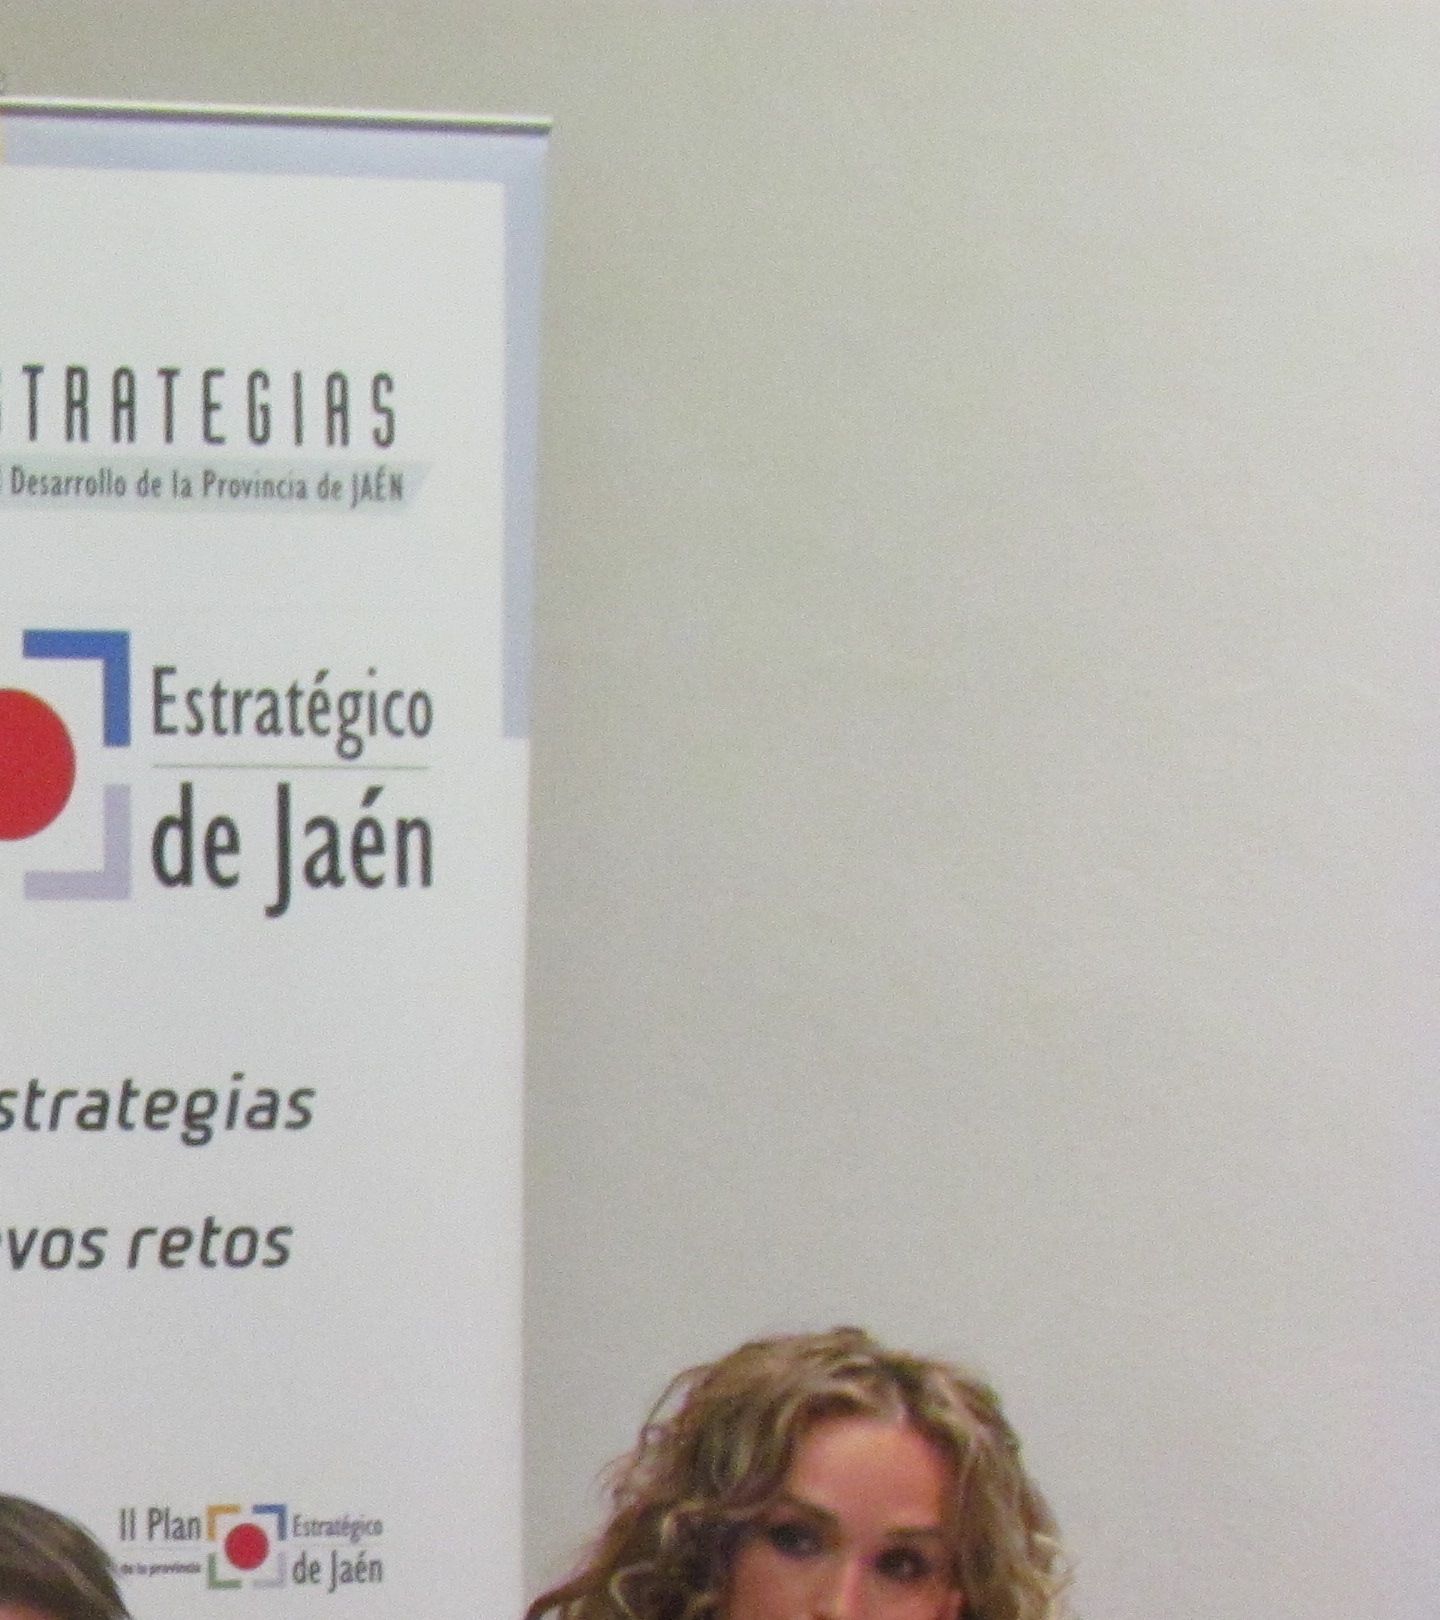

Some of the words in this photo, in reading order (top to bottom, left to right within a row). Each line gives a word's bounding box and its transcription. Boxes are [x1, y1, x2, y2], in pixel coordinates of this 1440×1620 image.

[11, 464, 127, 497] Desarrollo
[135, 469, 163, 498] de
[171, 470, 193, 499] la
[202, 468, 307, 501] Provincia
[316, 472, 343, 501] de
[350, 465, 404, 509] JAÉN
[152, 663, 433, 760] Estratégico
[152, 782, 241, 889] de
[265, 782, 433, 919] Jaén
[127, 1215, 295, 1270] retos
[120, 1506, 136, 1542] II
[147, 1506, 202, 1542] Plan
[292, 1514, 384, 1545] Estratégico
[292, 1550, 320, 1585] de
[327, 1549, 384, 1594] Jaén
